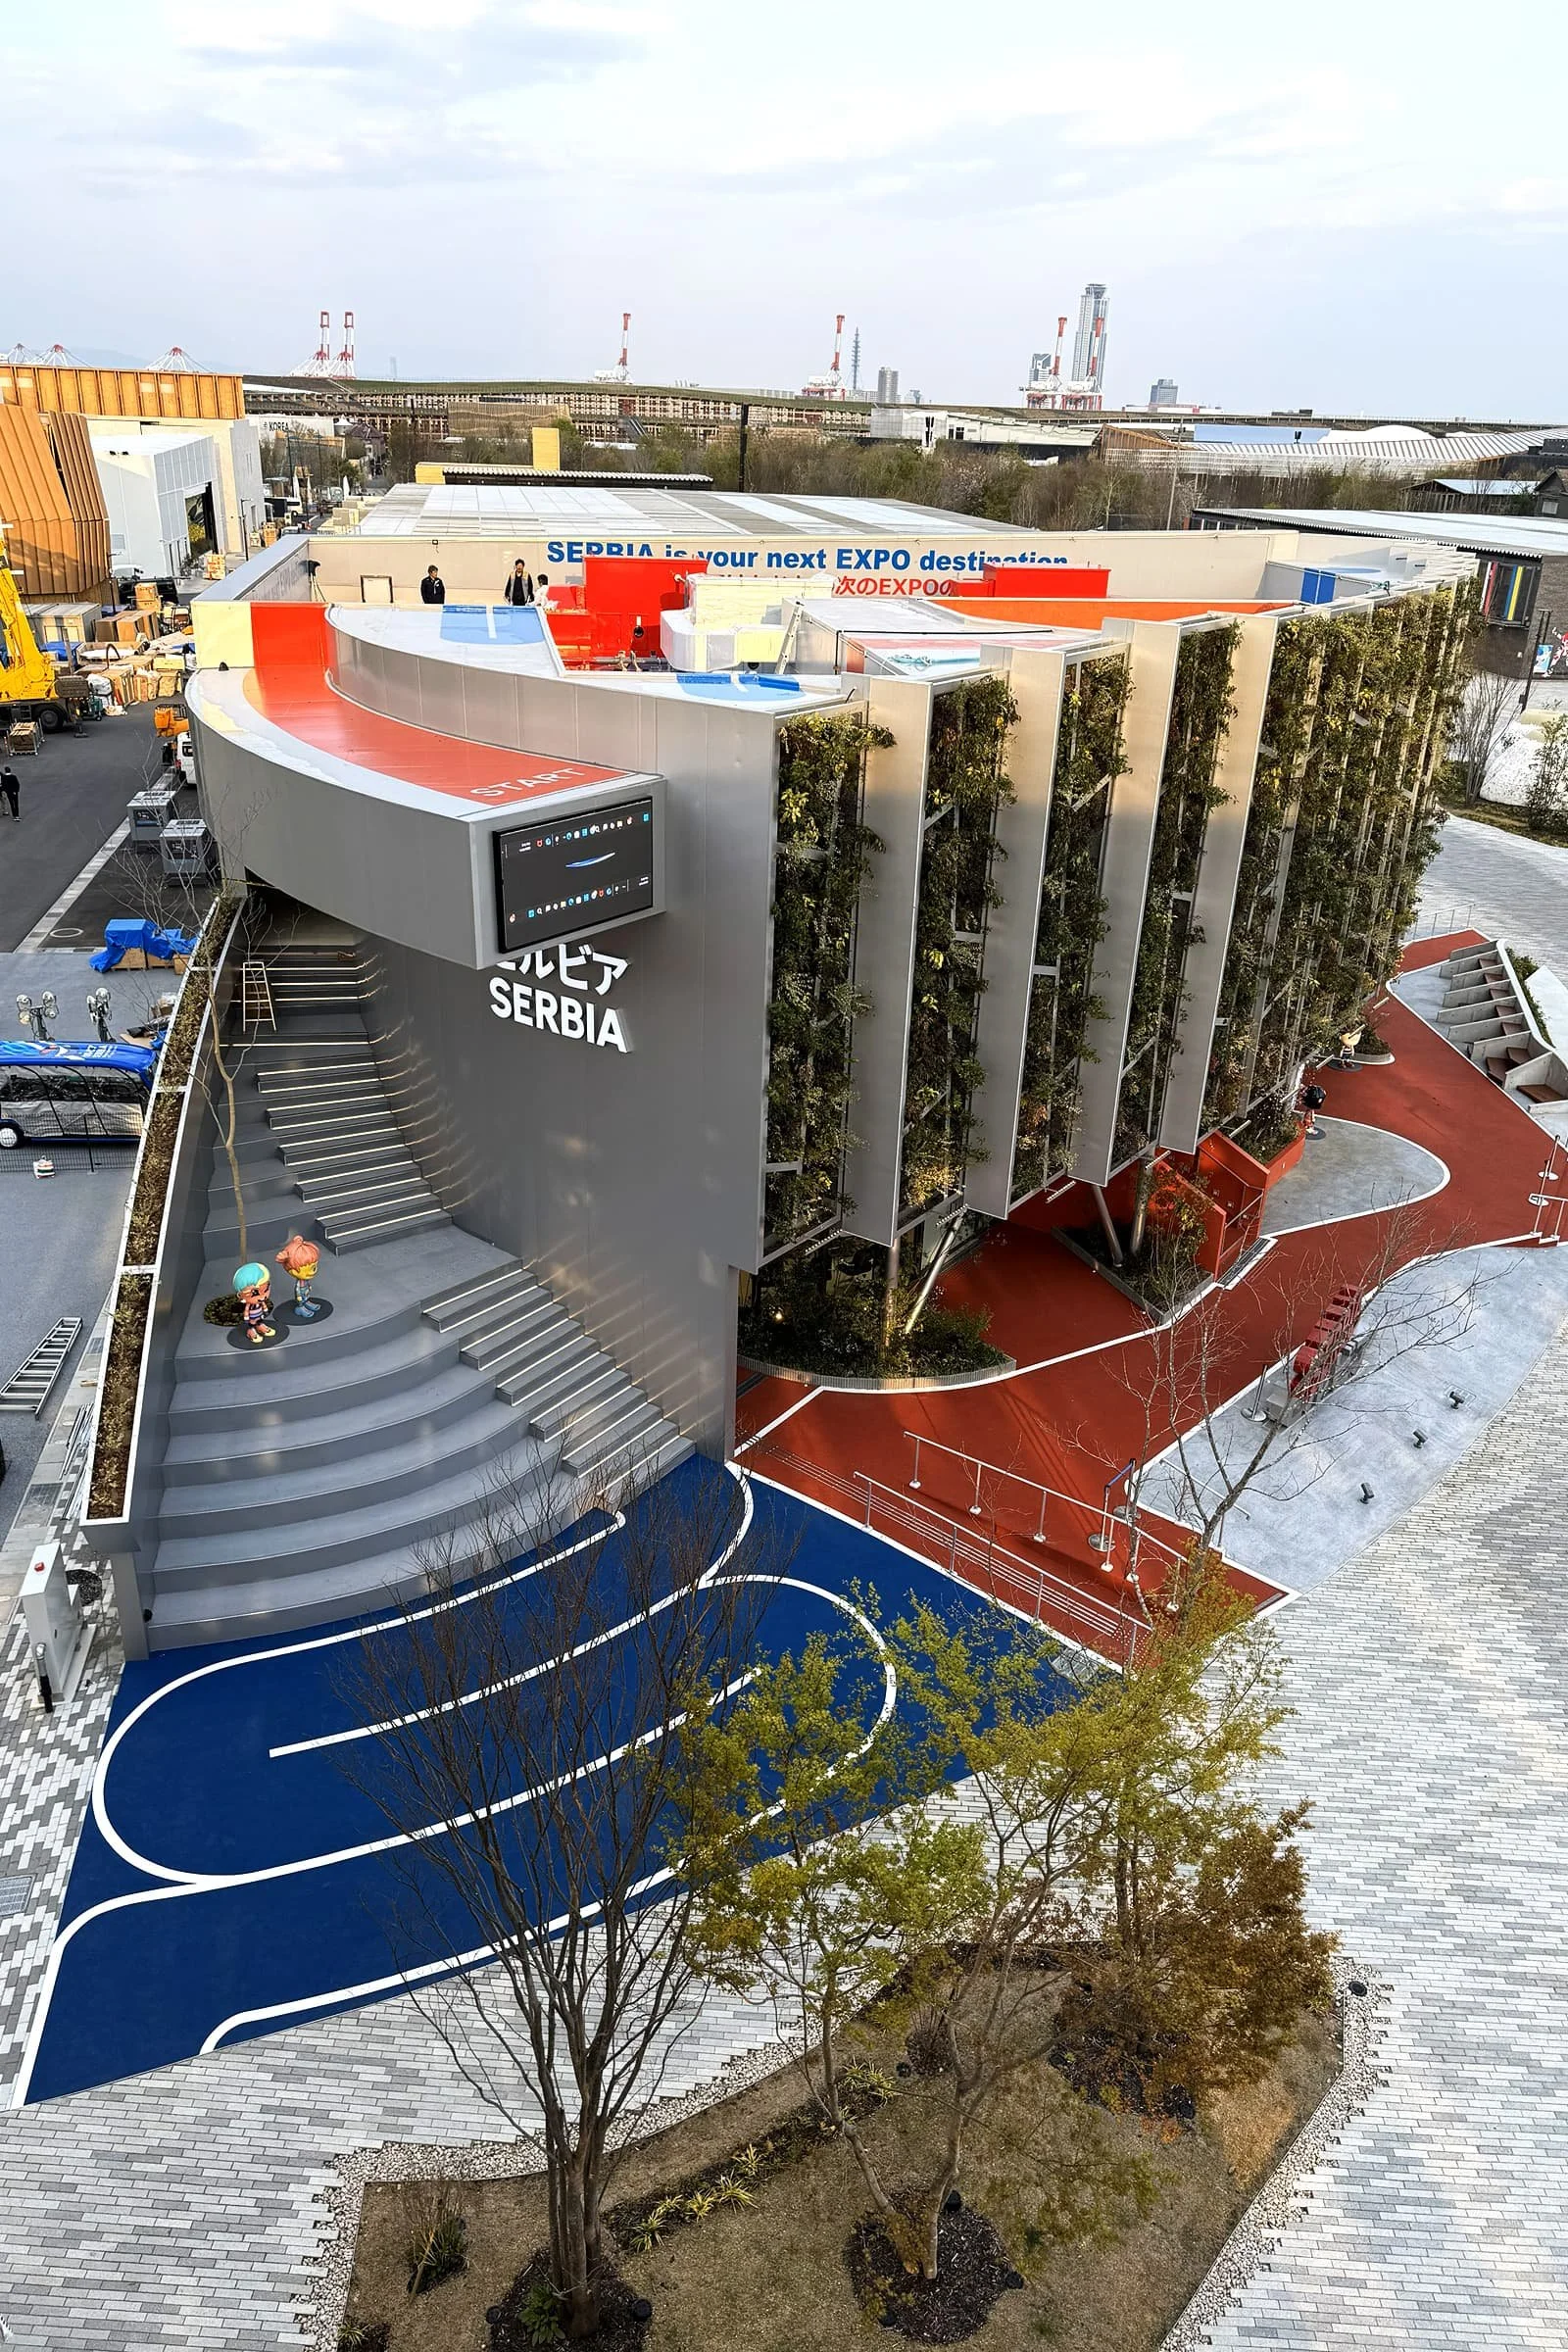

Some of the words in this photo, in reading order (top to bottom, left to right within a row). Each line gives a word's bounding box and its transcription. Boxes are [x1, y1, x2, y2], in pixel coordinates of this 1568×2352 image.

[269, 421, 289, 432] KOREA
[766, 548, 827, 569] next
[836, 548, 910, 570] EXPO
[469, 767, 586, 797] START
[489, 977, 629, 1054] SERBIA
